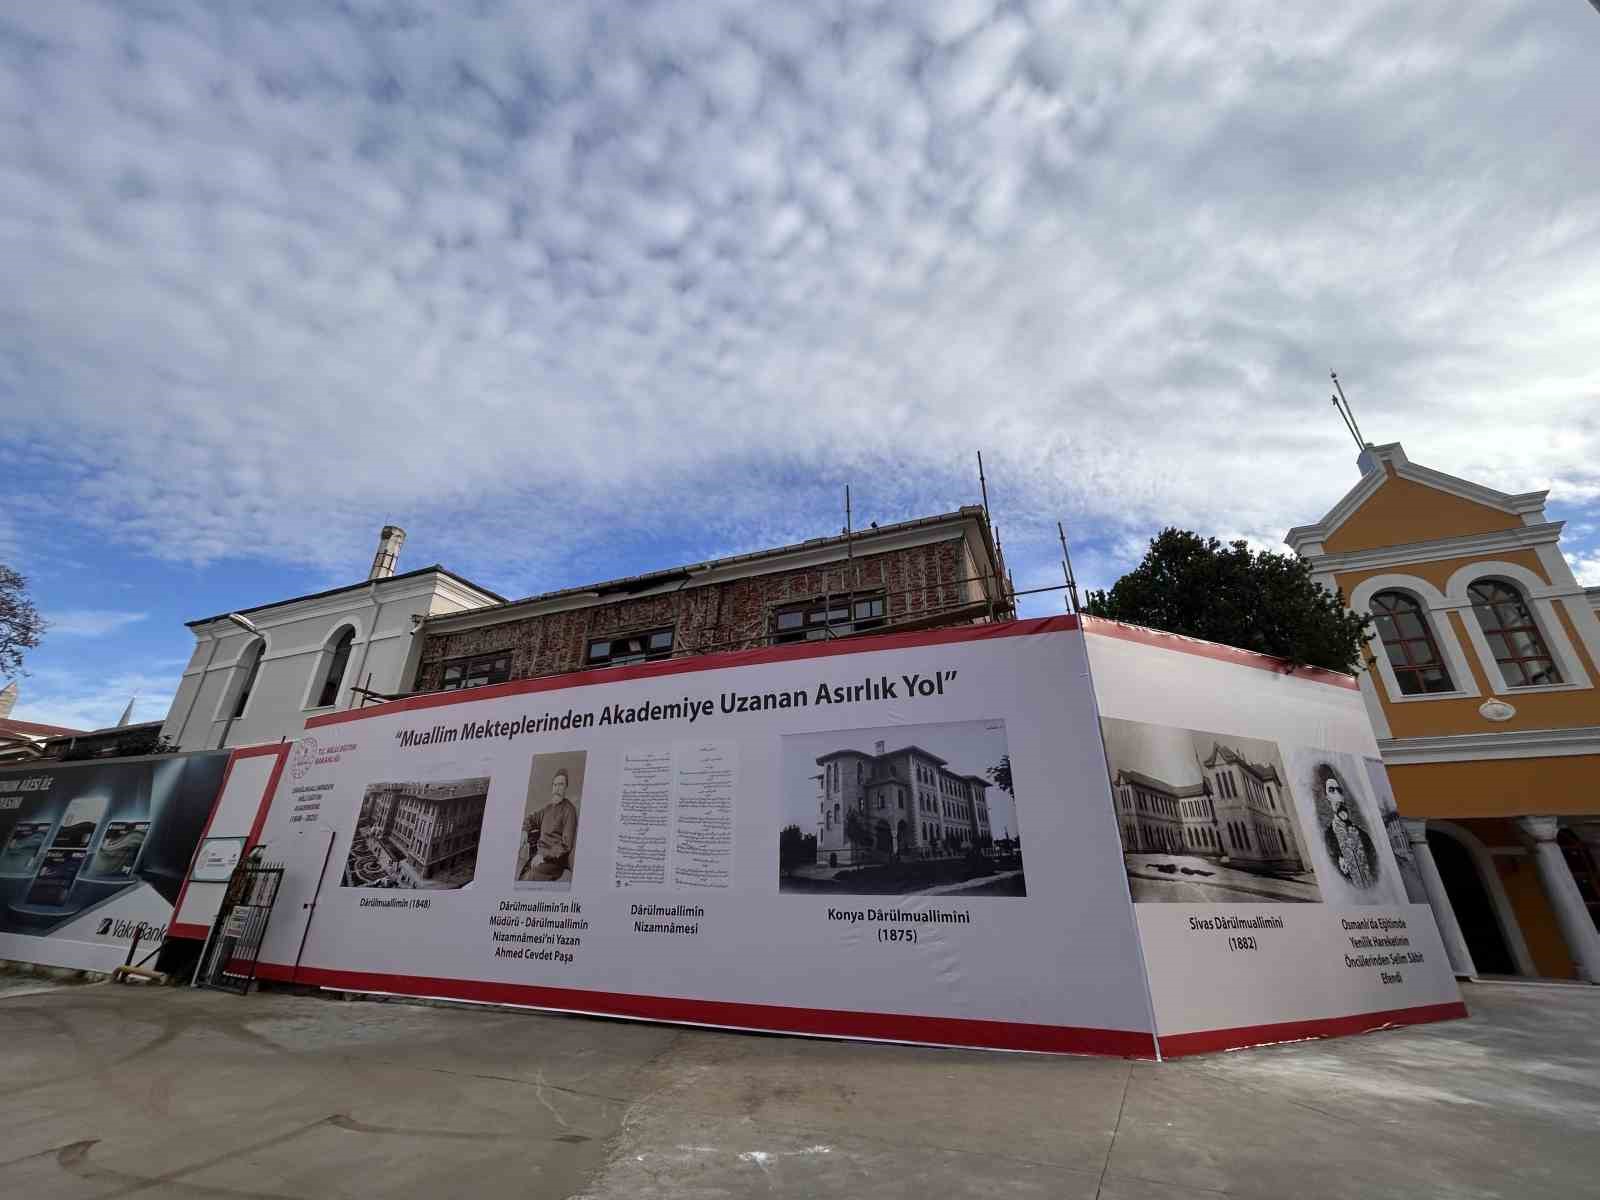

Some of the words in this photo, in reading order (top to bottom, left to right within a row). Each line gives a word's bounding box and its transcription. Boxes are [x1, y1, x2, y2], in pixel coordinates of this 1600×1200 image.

[395, 725, 458, 748] “Muallim
[461, 709, 594, 741] Mekteplerinden
[599, 697, 714, 726] Akademiye
[720, 688, 808, 714] Uzanan
[815, 676, 898, 705] Asırlık
[902, 670, 957, 697] Yol”
[409, 899, 431, 911] (1848)
[570, 900, 581, 913] İlk
[489, 915, 520, 928] Müdürü
[828, 908, 864, 924] Konya
[867, 907, 971, 924] Dârülmuallimîni
[1189, 917, 1214, 930] Sivas
[556, 934, 580, 946] Yazan
[878, 928, 918, 944] (1875)
[1348, 936, 1373, 948] Yenilik
[1228, 935, 1257, 952] (1882)
[494, 947, 523, 960] Ahmed
[524, 948, 553, 961] Cevdet
[554, 950, 574, 963] Paşa
[1381, 971, 1404, 985] Efendi
